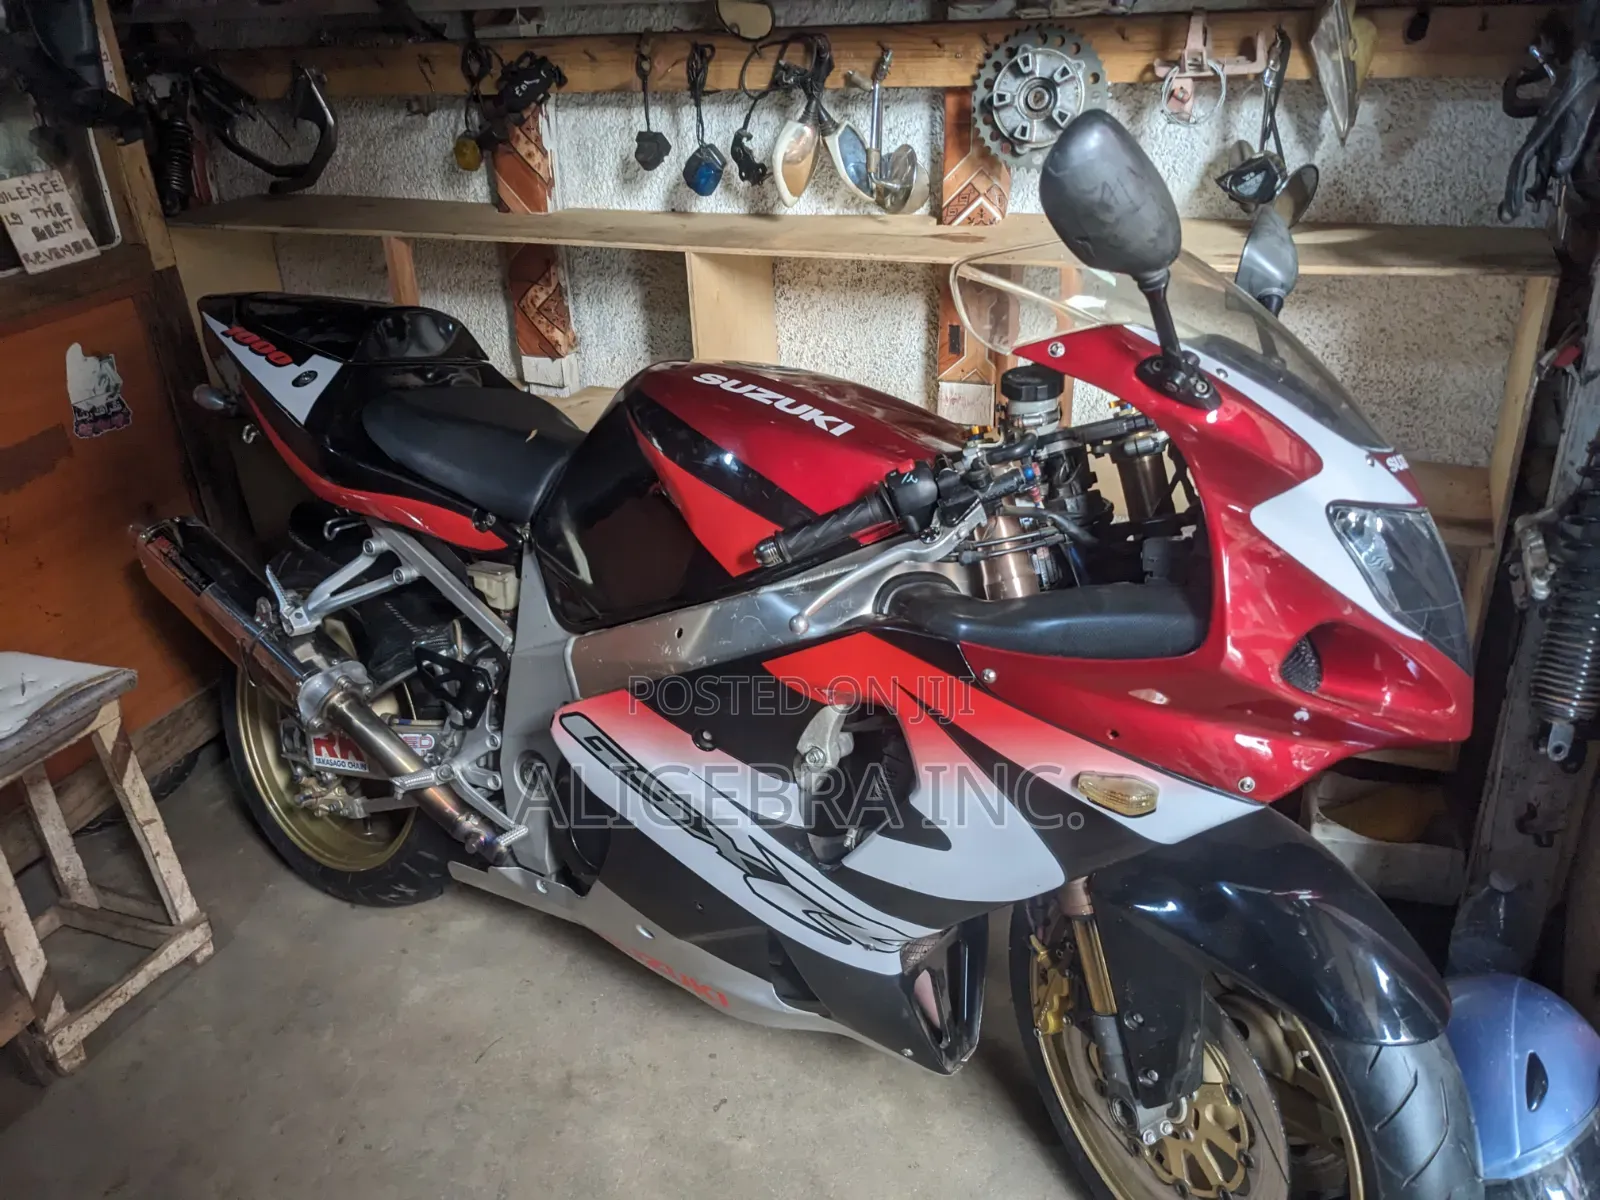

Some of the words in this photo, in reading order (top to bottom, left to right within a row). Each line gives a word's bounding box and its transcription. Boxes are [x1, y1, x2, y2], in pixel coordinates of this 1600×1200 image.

[30, 202, 69, 219] THE
[31, 218, 73, 242] BEST
[22, 238, 96, 265] REVENGE
[221, 326, 294, 367] 1000
[692, 373, 856, 437] SUZUKI
[315, 757, 347, 768] TAKASAGO
